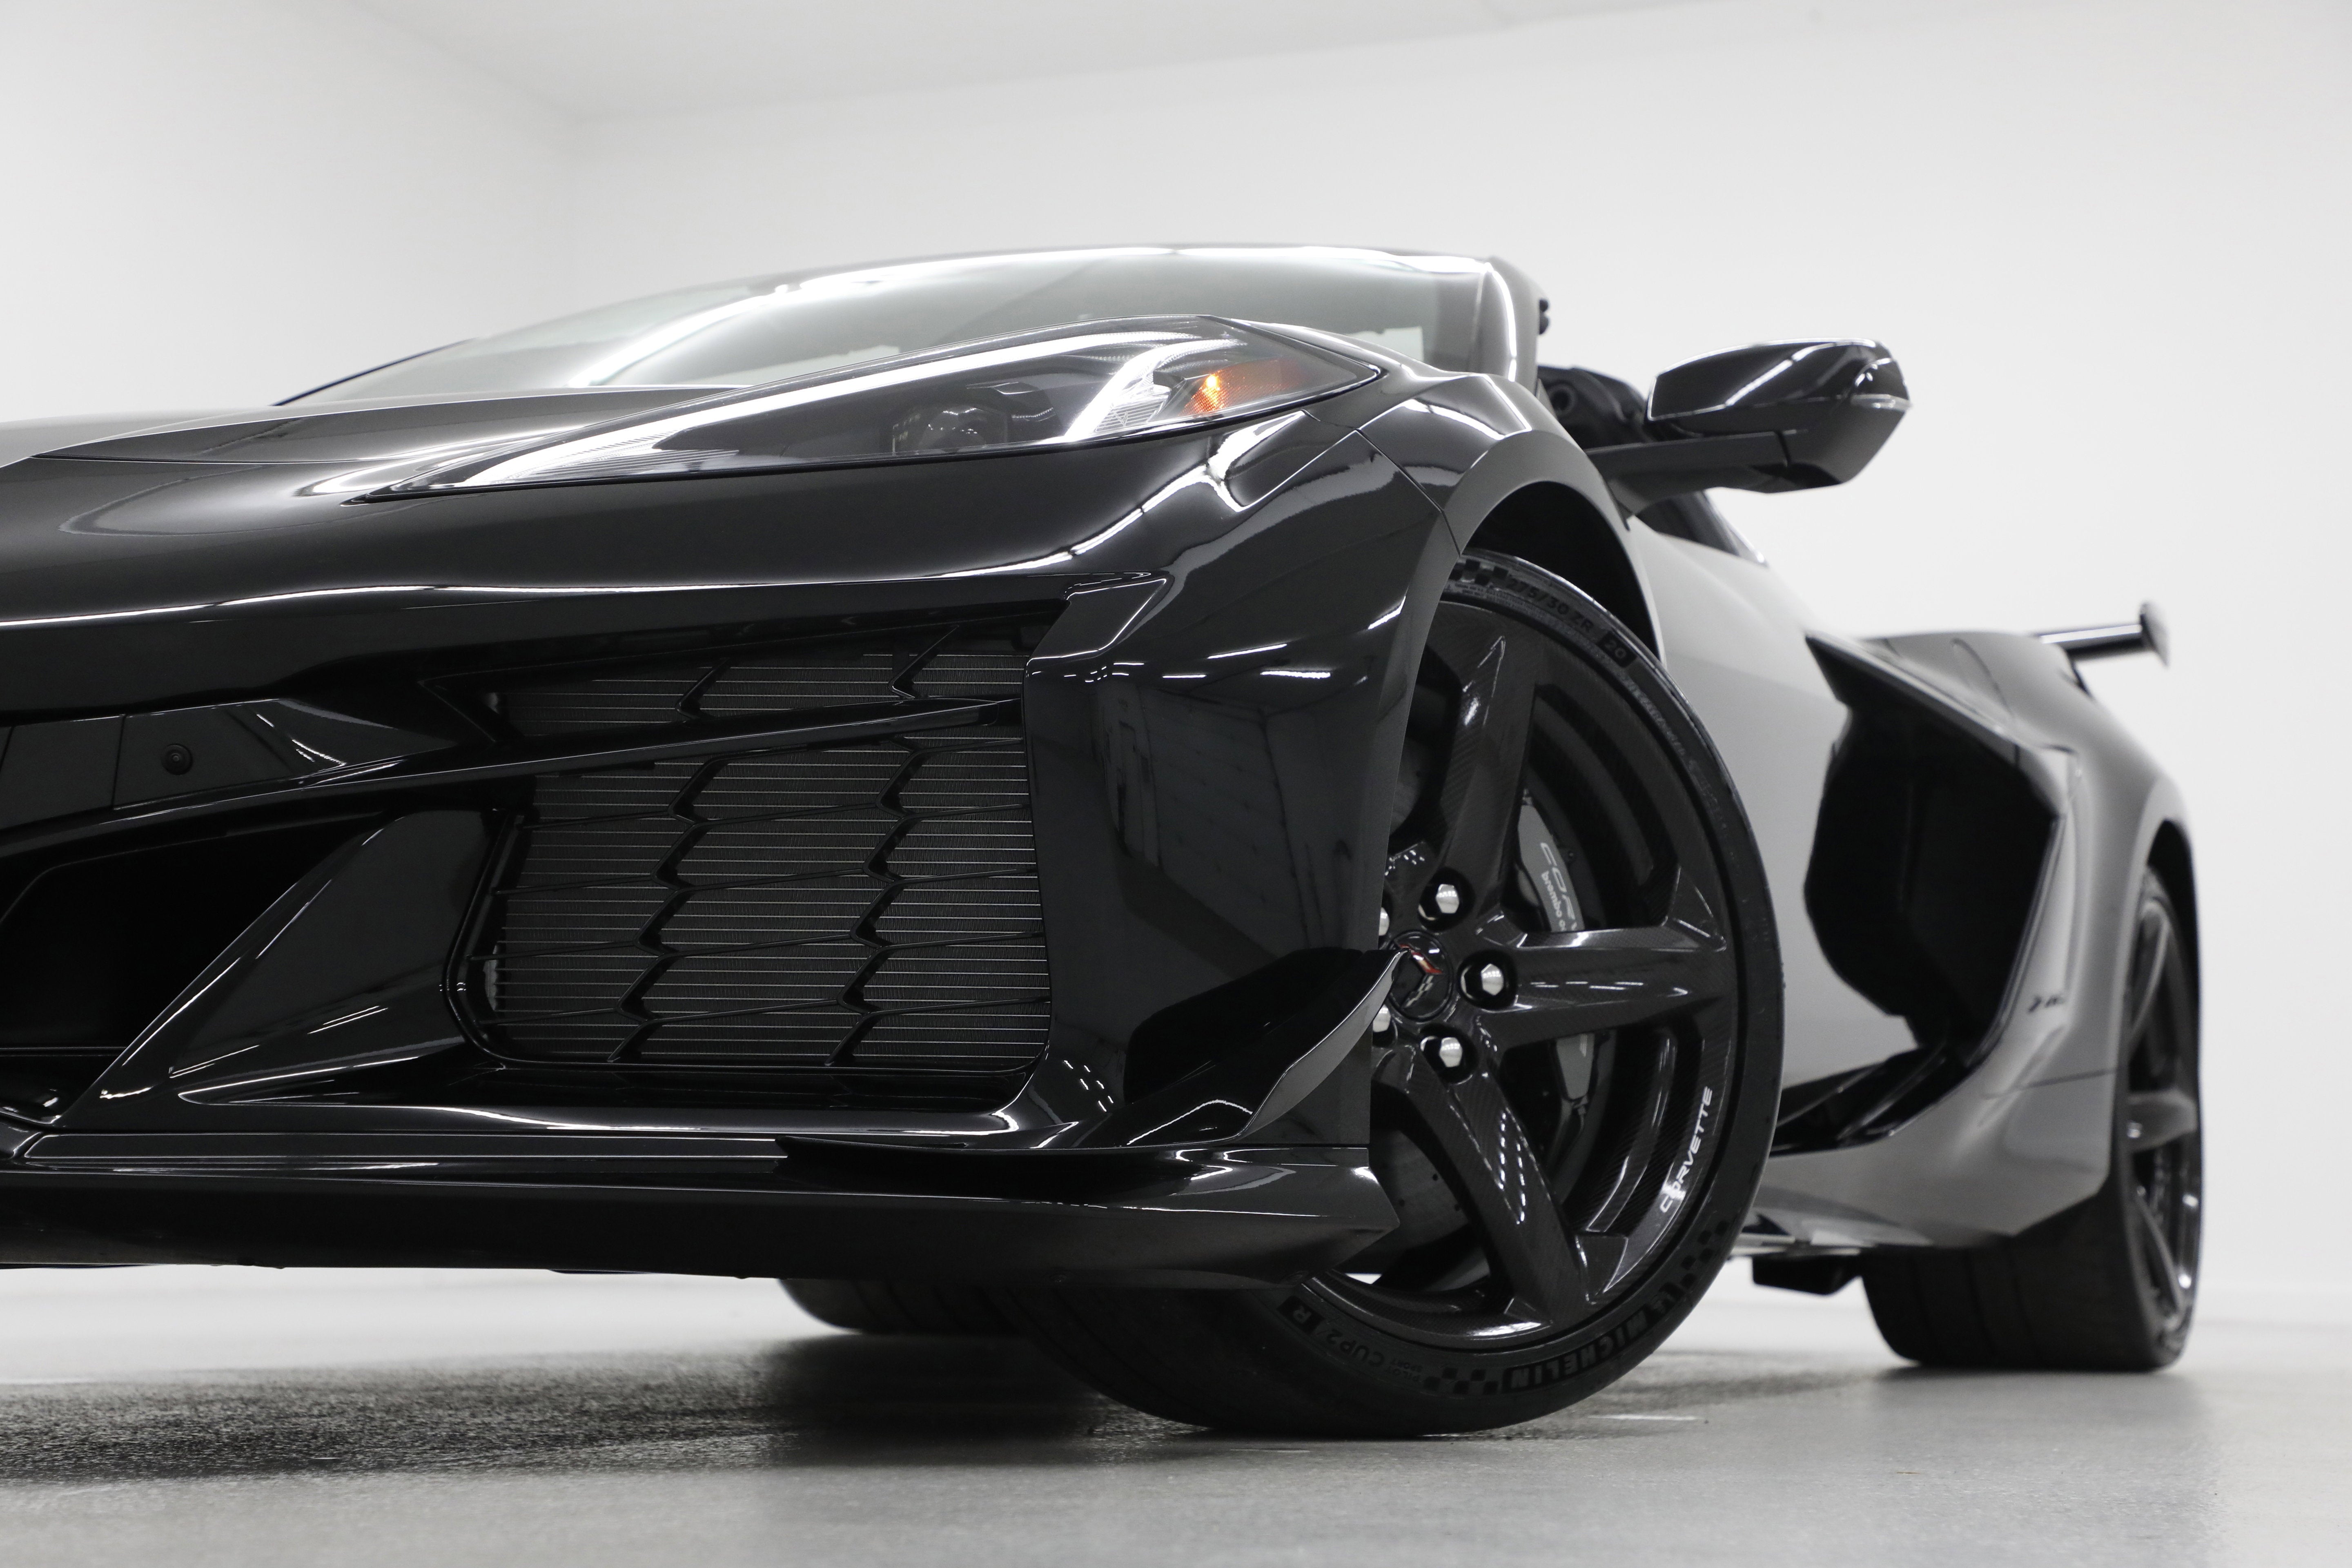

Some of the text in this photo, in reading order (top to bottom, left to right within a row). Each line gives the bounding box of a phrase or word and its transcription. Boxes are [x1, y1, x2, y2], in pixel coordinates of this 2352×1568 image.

[1506, 577, 1570, 615] 275/30
[1604, 639, 1626, 659] 20
[1541, 869, 1563, 918] brembo
[1659, 1086, 1713, 1214] CORVETTE
[1292, 1306, 1312, 1324] R
[1511, 1310, 1648, 1388] MICHELIN
